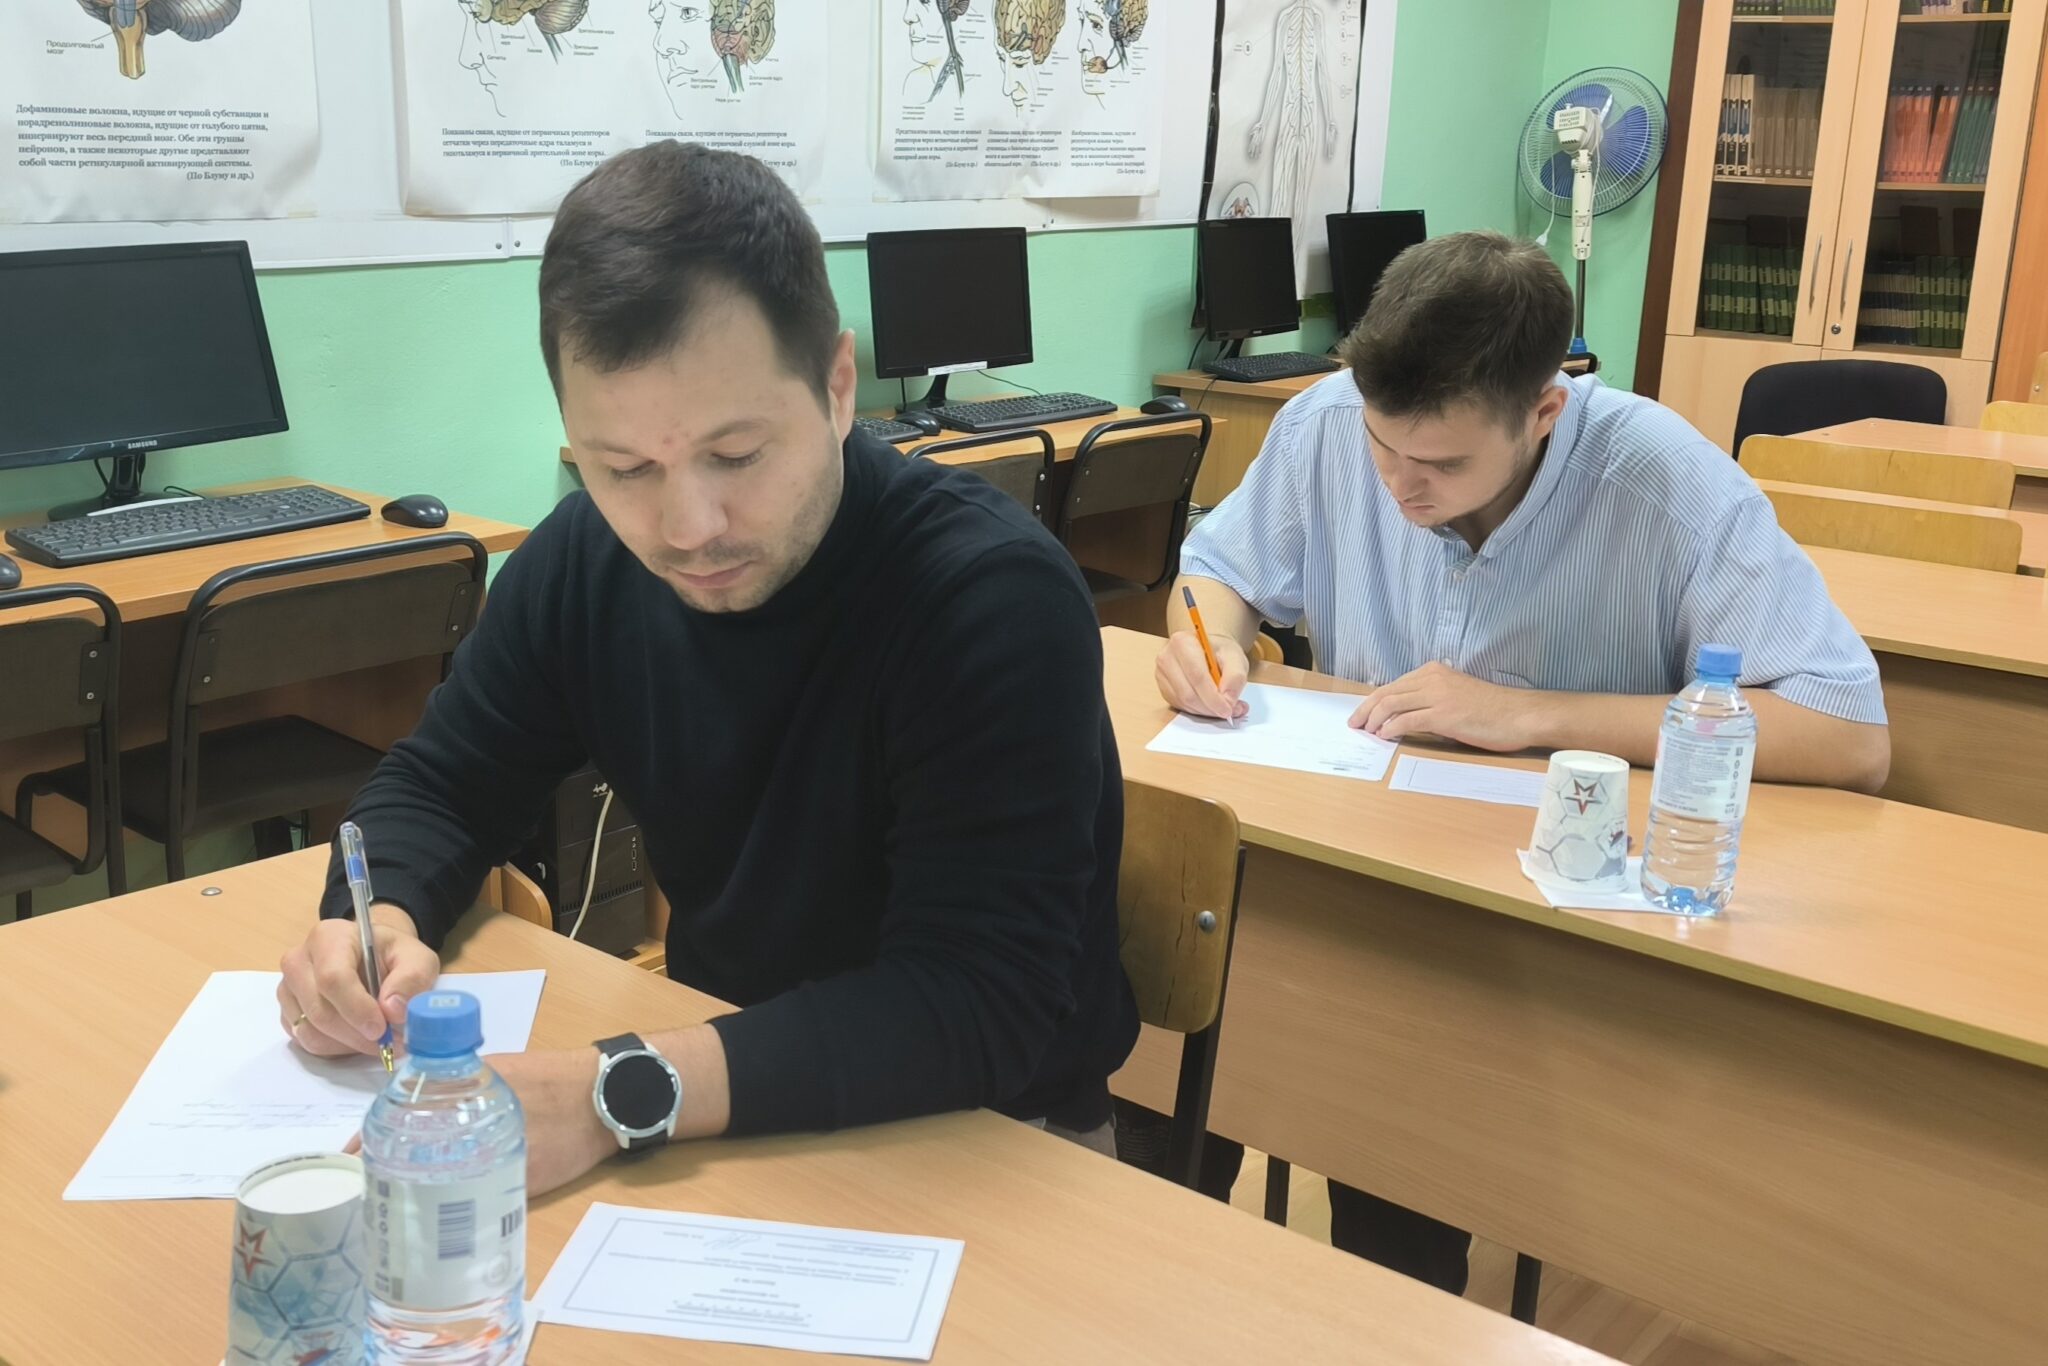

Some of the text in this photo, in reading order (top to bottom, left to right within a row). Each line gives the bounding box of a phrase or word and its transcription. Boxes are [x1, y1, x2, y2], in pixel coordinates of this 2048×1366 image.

[46, 39, 105, 49] Продолговатый
[16, 104, 87, 115] Дофаминовые
[88, 106, 131, 116] волокна,
[132, 108, 166, 117] идущие
[179, 108, 211, 118] черной
[213, 109, 261, 119] субстанции
[113, 121, 153, 131] волокна,
[155, 123, 188, 131] идущие
[202, 121, 240, 132] голубого
[241, 124, 268, 132] пятна,
[18, 132, 84, 142] иннервируют
[86, 133, 106, 141] весь
[108, 132, 152, 143] передний
[178, 133, 195, 142] Обе
[213, 136, 245, 144] группы
[18, 144, 68, 155] нейронов,
[107, 147, 157, 156] некоторые
[159, 148, 189, 156] другие
[190, 147, 250, 156] представляют
[18, 157, 47, 167] собой
[48, 159, 76, 167] части
[79, 159, 145, 169] ретикулярной
[146, 159, 213, 169] активирующей
[186, 171, 203, 181] (По
[204, 171, 229, 181] Блуму
[237, 172, 255, 181] др.)
[127, 439, 158, 450] SAMSUNG
